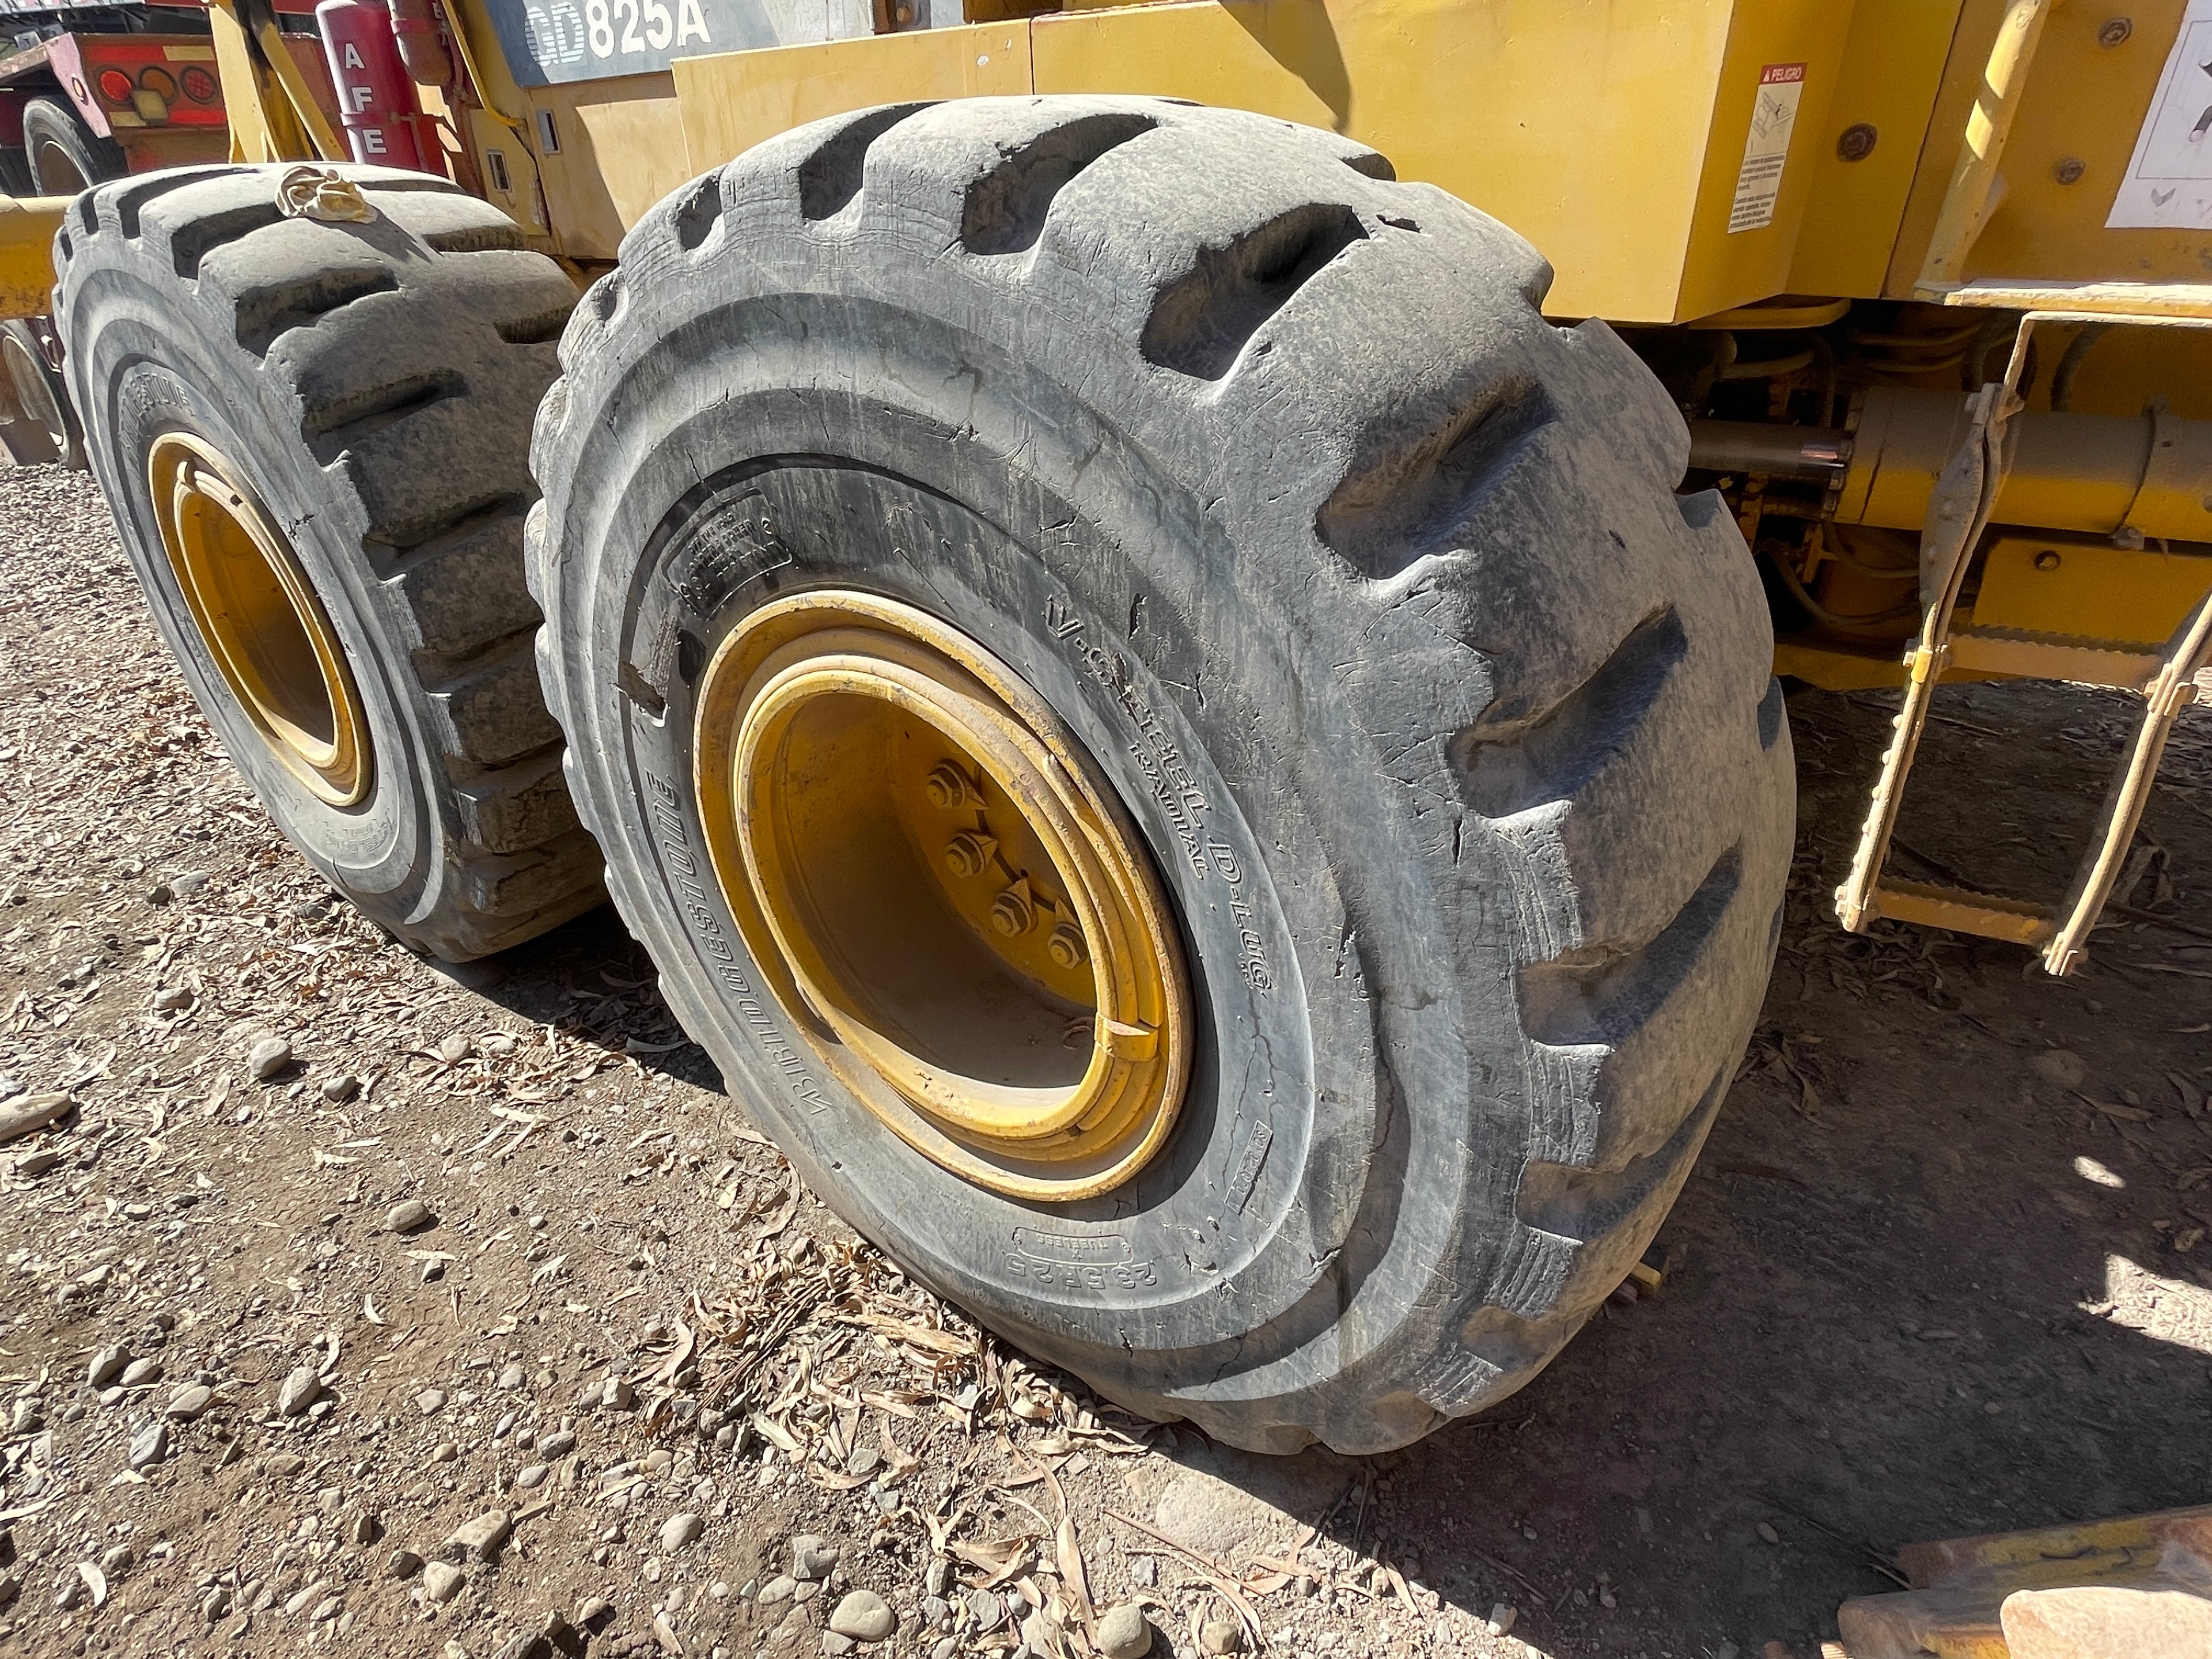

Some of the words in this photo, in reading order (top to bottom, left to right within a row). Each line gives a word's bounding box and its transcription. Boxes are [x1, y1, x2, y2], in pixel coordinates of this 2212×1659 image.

[1771, 67, 1802, 81] PELIGRO
[1130, 742, 1209, 880] RADIAL
[645, 769, 834, 1115] BRIDGESTONE
[1209, 843, 1273, 991] D-LUG
[1036, 1233, 1108, 1249] TUBELESS
